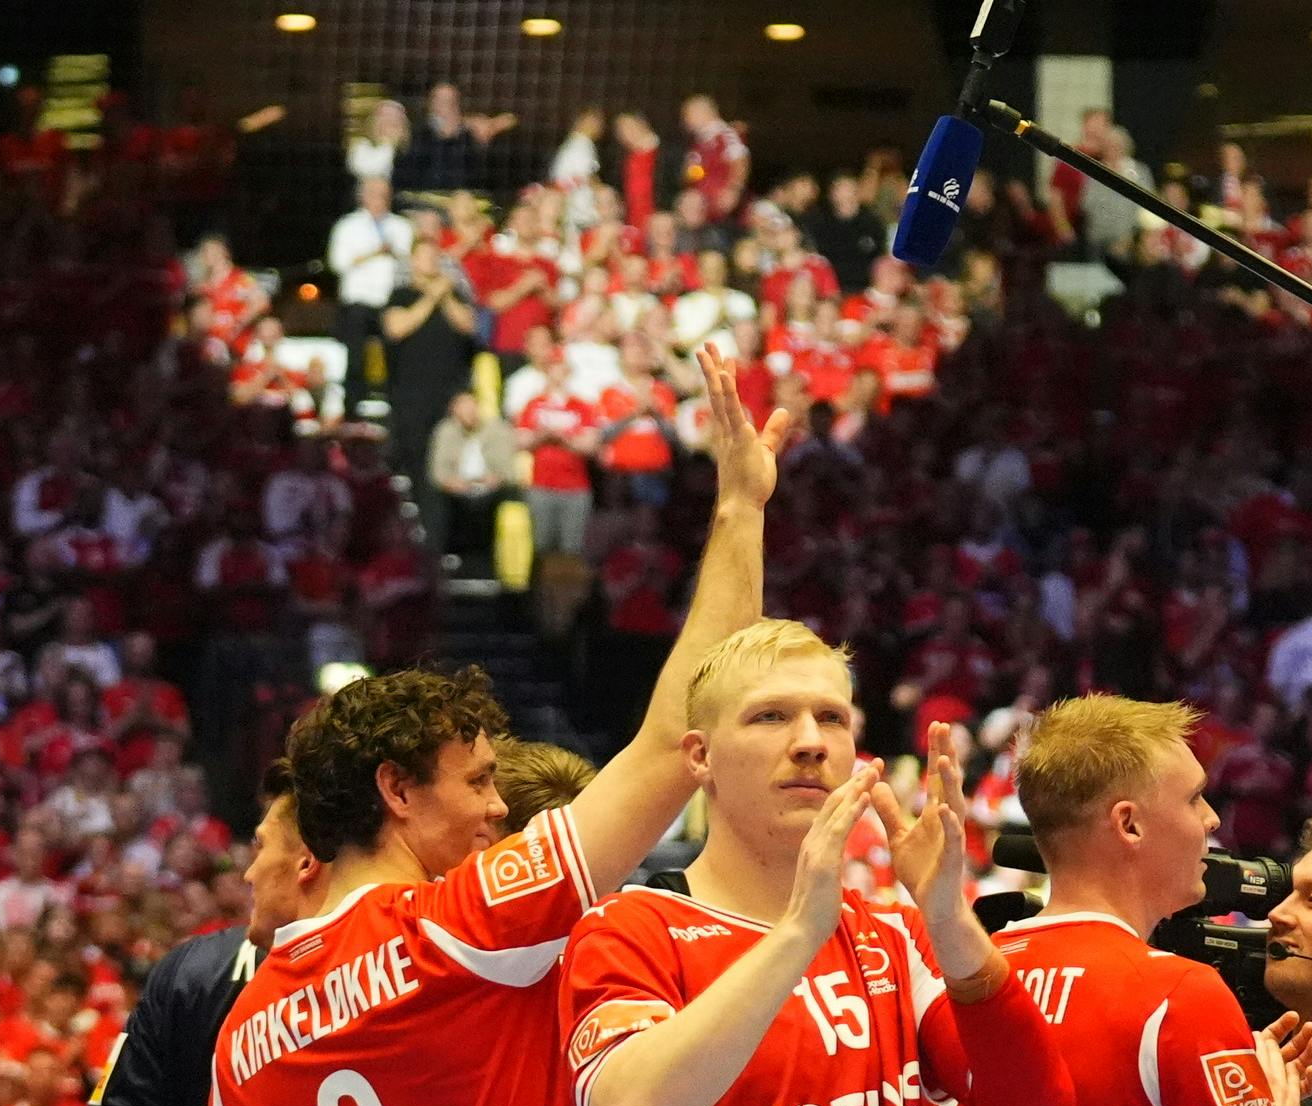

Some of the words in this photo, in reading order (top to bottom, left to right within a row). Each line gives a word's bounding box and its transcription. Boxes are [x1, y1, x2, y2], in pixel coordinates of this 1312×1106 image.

[668, 924, 732, 942] NORLYS
[231, 934, 420, 1087] KIRKELØKKE
[793, 970, 871, 1057] 15
[1016, 966, 1086, 1025] OLT
